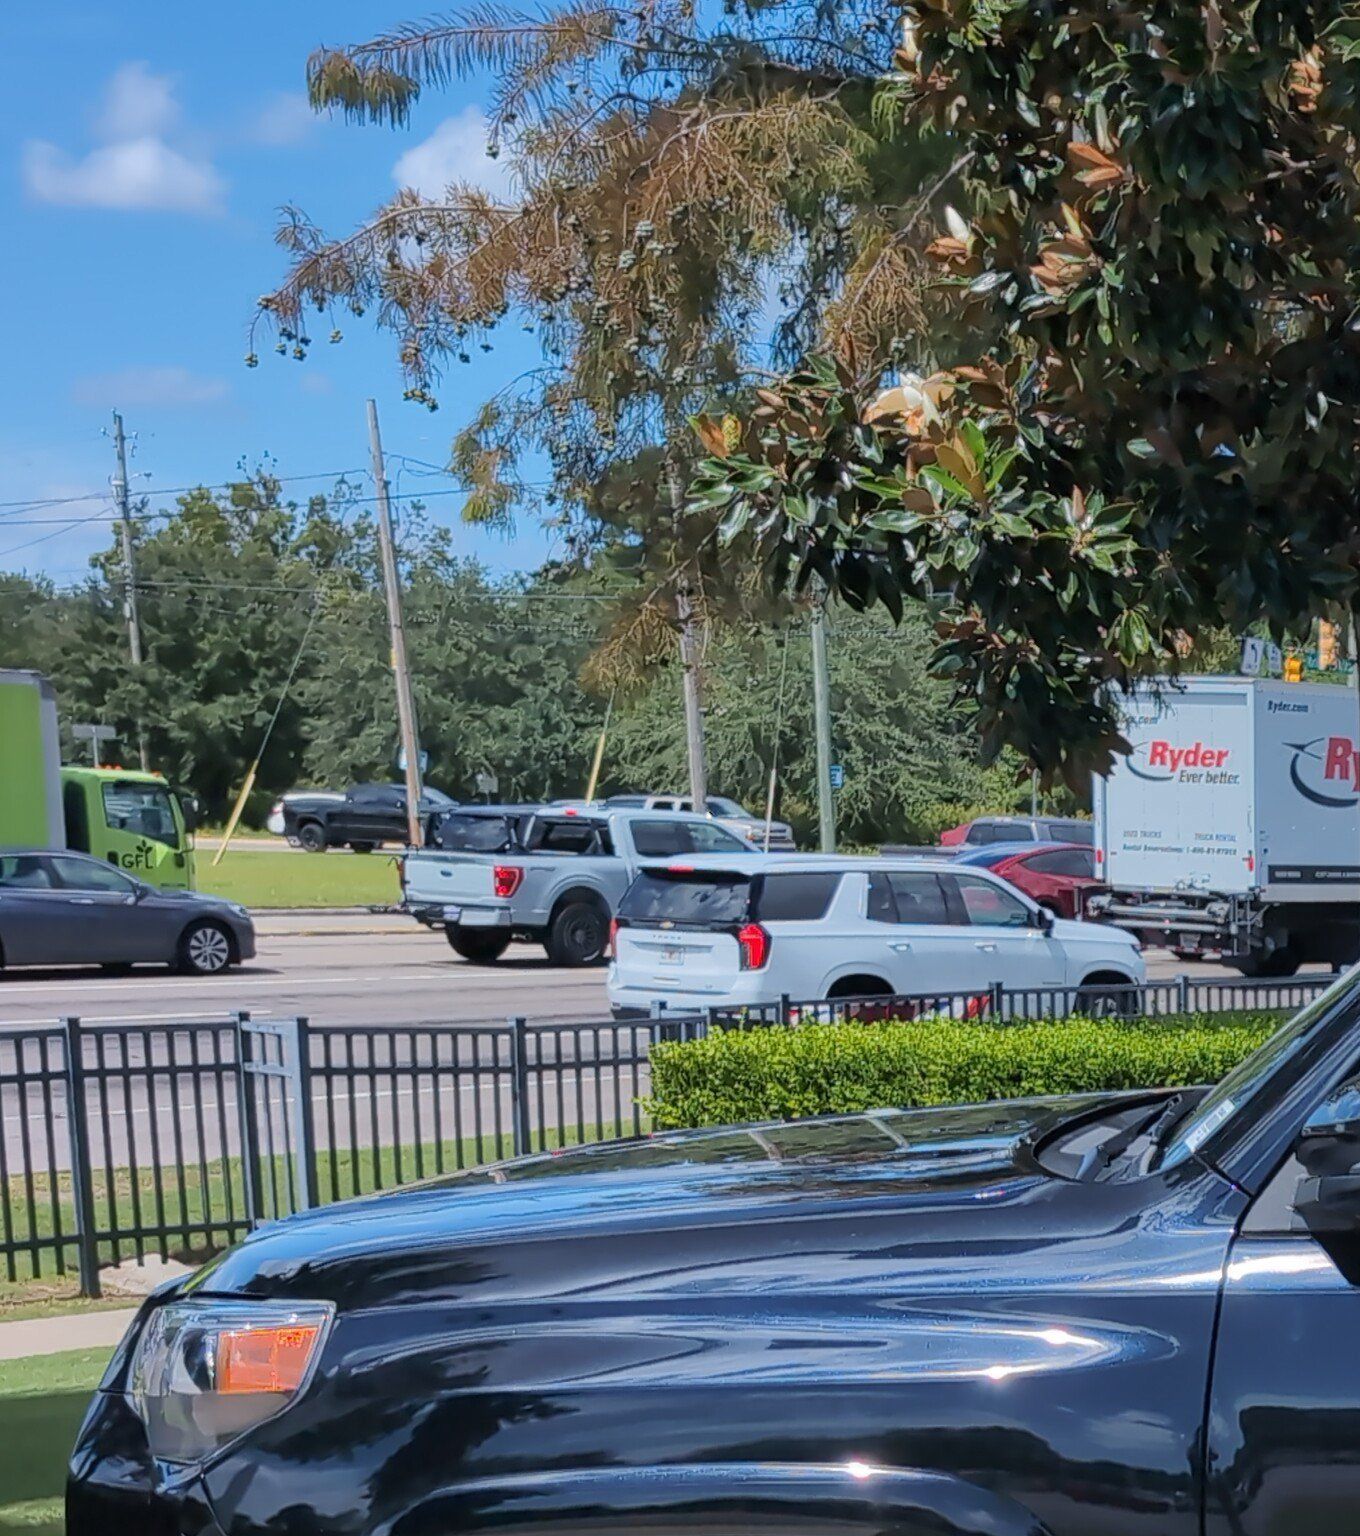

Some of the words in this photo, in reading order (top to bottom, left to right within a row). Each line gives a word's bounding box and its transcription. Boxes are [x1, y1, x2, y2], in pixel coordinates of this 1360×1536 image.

[1267, 701, 1309, 713] Ryder.com
[1149, 741, 1229, 773] Ryder
[1178, 769, 1203, 784] Ever
[121, 848, 154, 870] GFL
